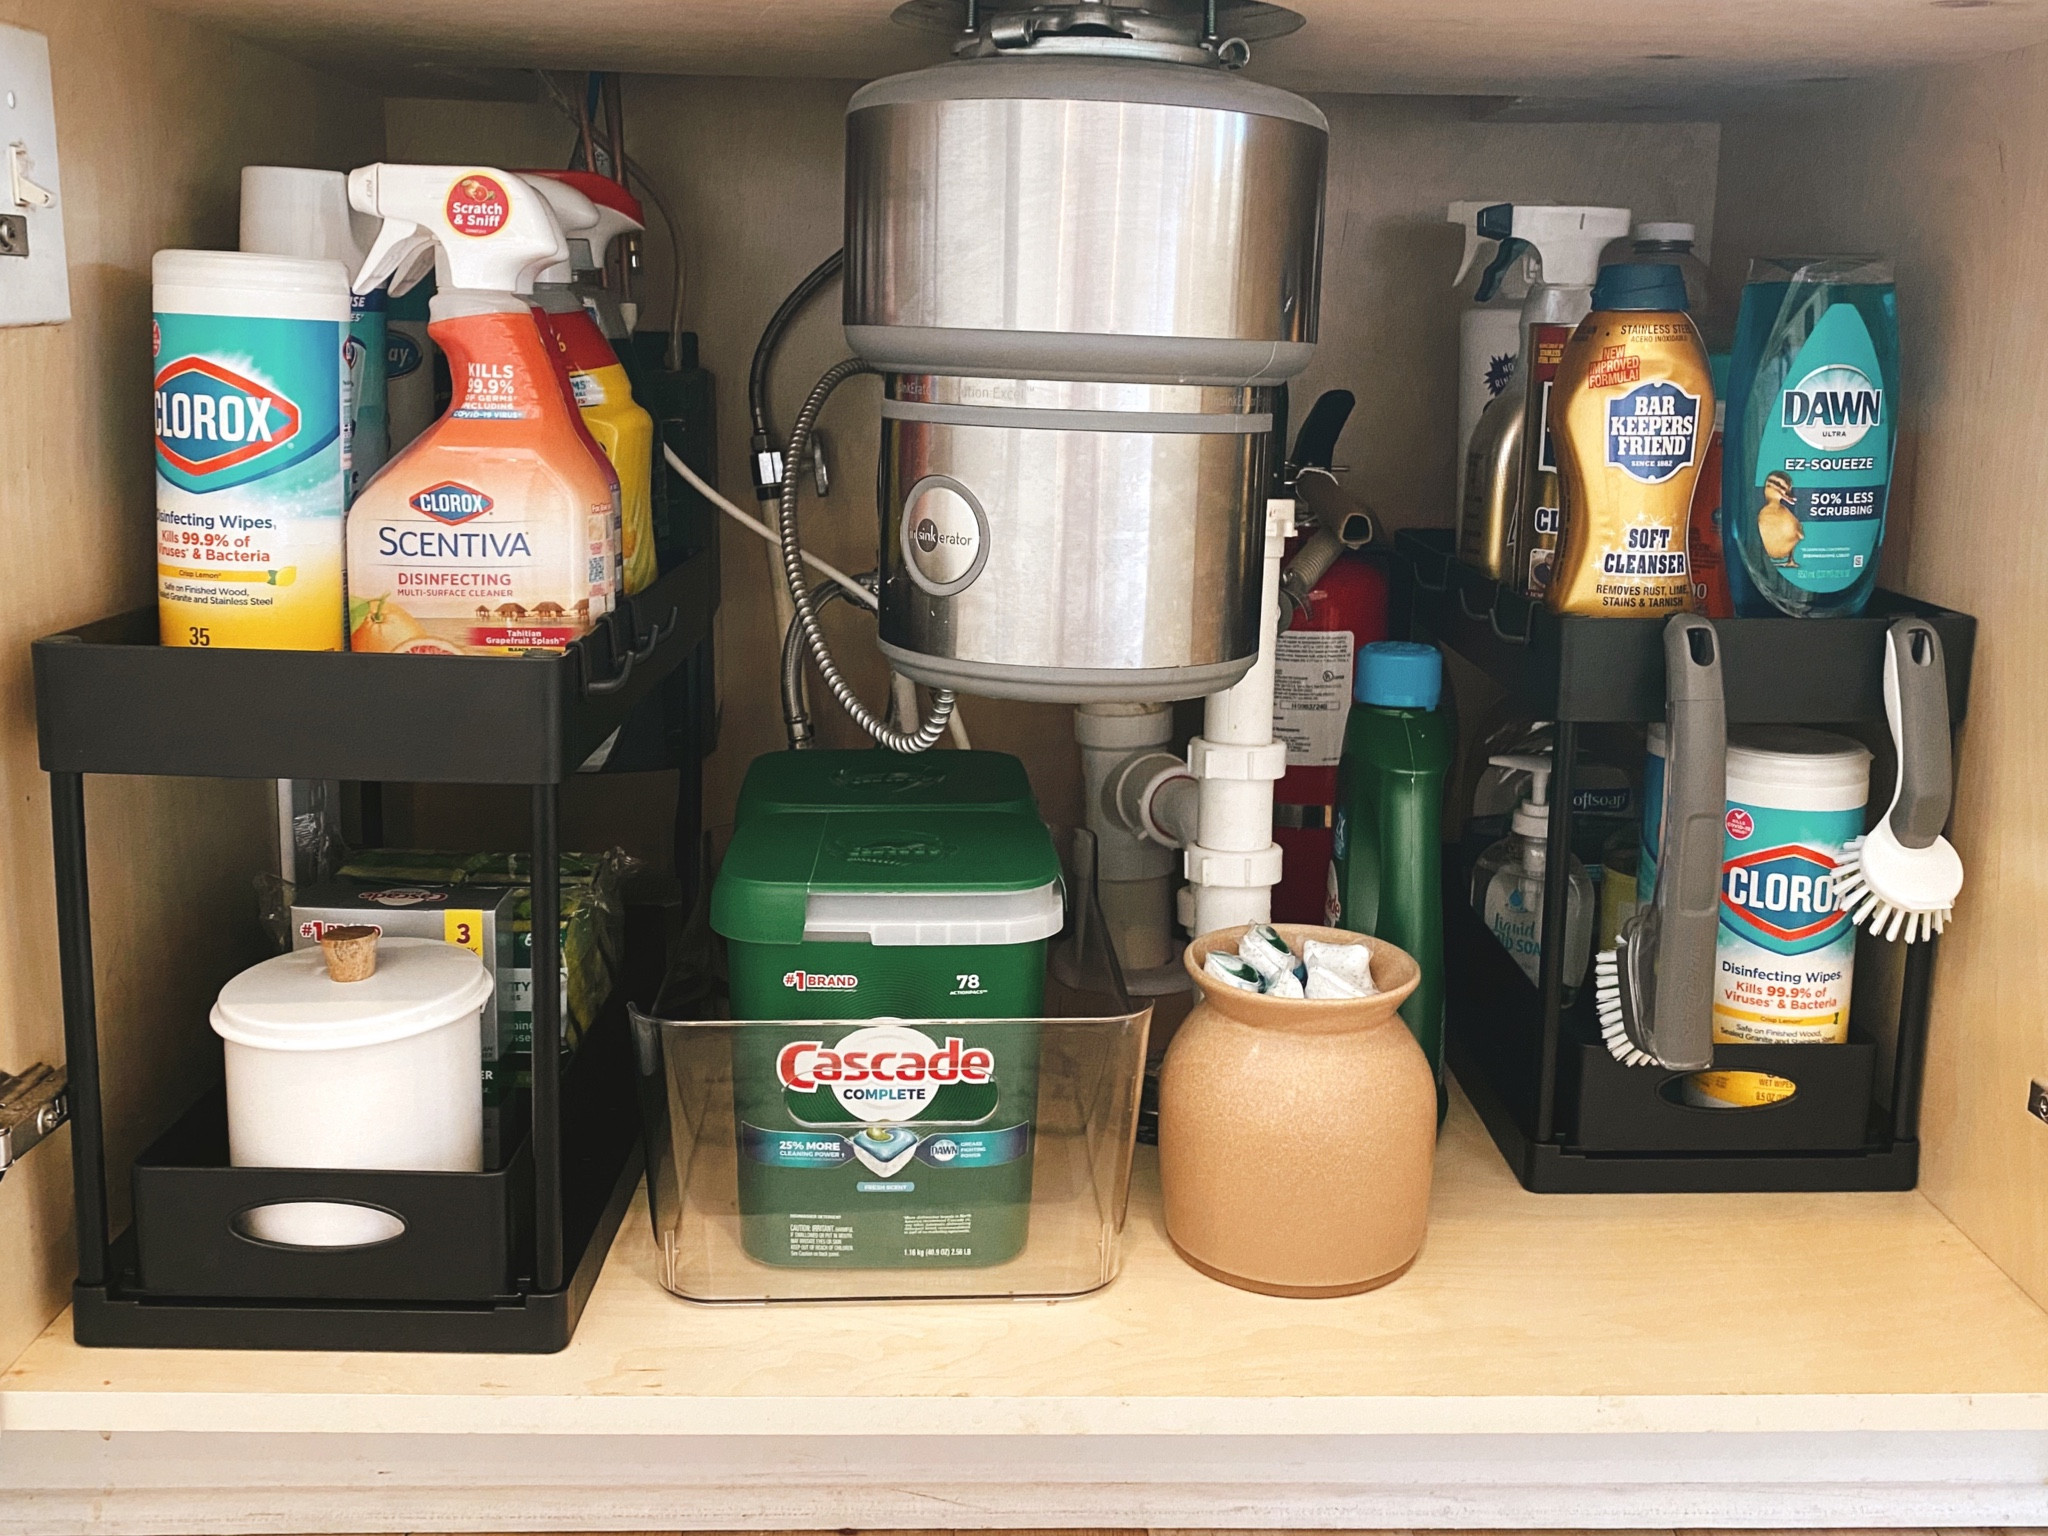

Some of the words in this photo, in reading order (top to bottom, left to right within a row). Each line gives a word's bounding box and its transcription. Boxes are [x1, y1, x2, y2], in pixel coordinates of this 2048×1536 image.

[452, 201, 503, 215] Scratch
[453, 213, 463, 225] &
[466, 214, 500, 227] Sniff
[1620, 324, 1671, 335] STAINLESS
[1603, 345, 1624, 360] NEW
[468, 362, 515, 379] KILLS
[1502, 362, 1515, 374] NO
[1589, 356, 1640, 376] IMPROVED
[1588, 368, 1640, 388] FORMULA!
[466, 378, 515, 395] 99.9%
[1634, 395, 1675, 416] BAR
[1782, 389, 1882, 427] DAWN
[1610, 415, 1694, 436] KEEPERS
[1822, 430, 1847, 438] ULTRA
[1617, 435, 1687, 456] FRIEND
[1784, 457, 1874, 471] EZ-SQUEEZE
[419, 493, 484, 513] CLOROX
[1810, 493, 1842, 505] 50%
[1845, 491, 1874, 504] LESS
[1809, 505, 1873, 517] SCRUBBING
[219, 515, 273, 531] Wipes
[162, 530, 179, 543] Kills
[181, 531, 230, 548] 99.9%
[233, 535, 251, 548] of
[378, 526, 532, 558] SCENTIVA
[1628, 528, 1670, 549] SOFT
[192, 547, 202, 560] &
[205, 548, 271, 562] Bacteria
[1603, 552, 1685, 575] CLEANSER
[397, 572, 512, 587] DISINFECTING
[185, 585, 217, 595] Finished
[218, 587, 250, 597] Wood,
[397, 589, 466, 597] MULTI-SURFACE
[468, 589, 514, 597] CLEANER
[1596, 583, 1641, 596] REMOVES
[1643, 585, 1667, 597] RUST,
[170, 592, 192, 603] Granite
[193, 594, 208, 604] and
[209, 595, 249, 606] Stainless
[249, 596, 274, 606] Steel
[1602, 596, 1636, 607] STAINS
[1638, 597, 1646, 608] &
[1648, 596, 1684, 607] TARNISH
[188, 626, 211, 647] 35
[506, 629, 542, 638] Tahitian
[485, 637, 530, 646] Grapefruit
[1573, 791, 1626, 810] oftsoap
[1728, 866, 1838, 913] CLORO
[456, 923, 471, 944] 3
[1722, 960, 1802, 985] Disinfecting
[1805, 969, 1842, 984] Wipes
[808, 975, 857, 987] BRAND
[956, 974, 981, 989] 78
[1736, 980, 1763, 996] Kills
[1766, 985, 1812, 999] 99.9%
[1814, 986, 1827, 998] of
[1724, 989, 1771, 1008] Viruses
[1776, 1000, 1787, 1010] &
[1790, 996, 1838, 1011] Bacteria
[1736, 1023, 1753, 1033] Safe
[1765, 1027, 1798, 1038] Finished
[1745, 1032, 1774, 1044] Granite
[778, 1037, 993, 1090] Cascade
[1759, 1078, 1773, 1087] WET
[1774, 1079, 1794, 1089] WIPES
[843, 1088, 926, 1101] COMPLETE
[779, 1141, 804, 1150] 25%
[806, 1141, 841, 1151] MORE
[930, 1145, 959, 1156] DAWN
